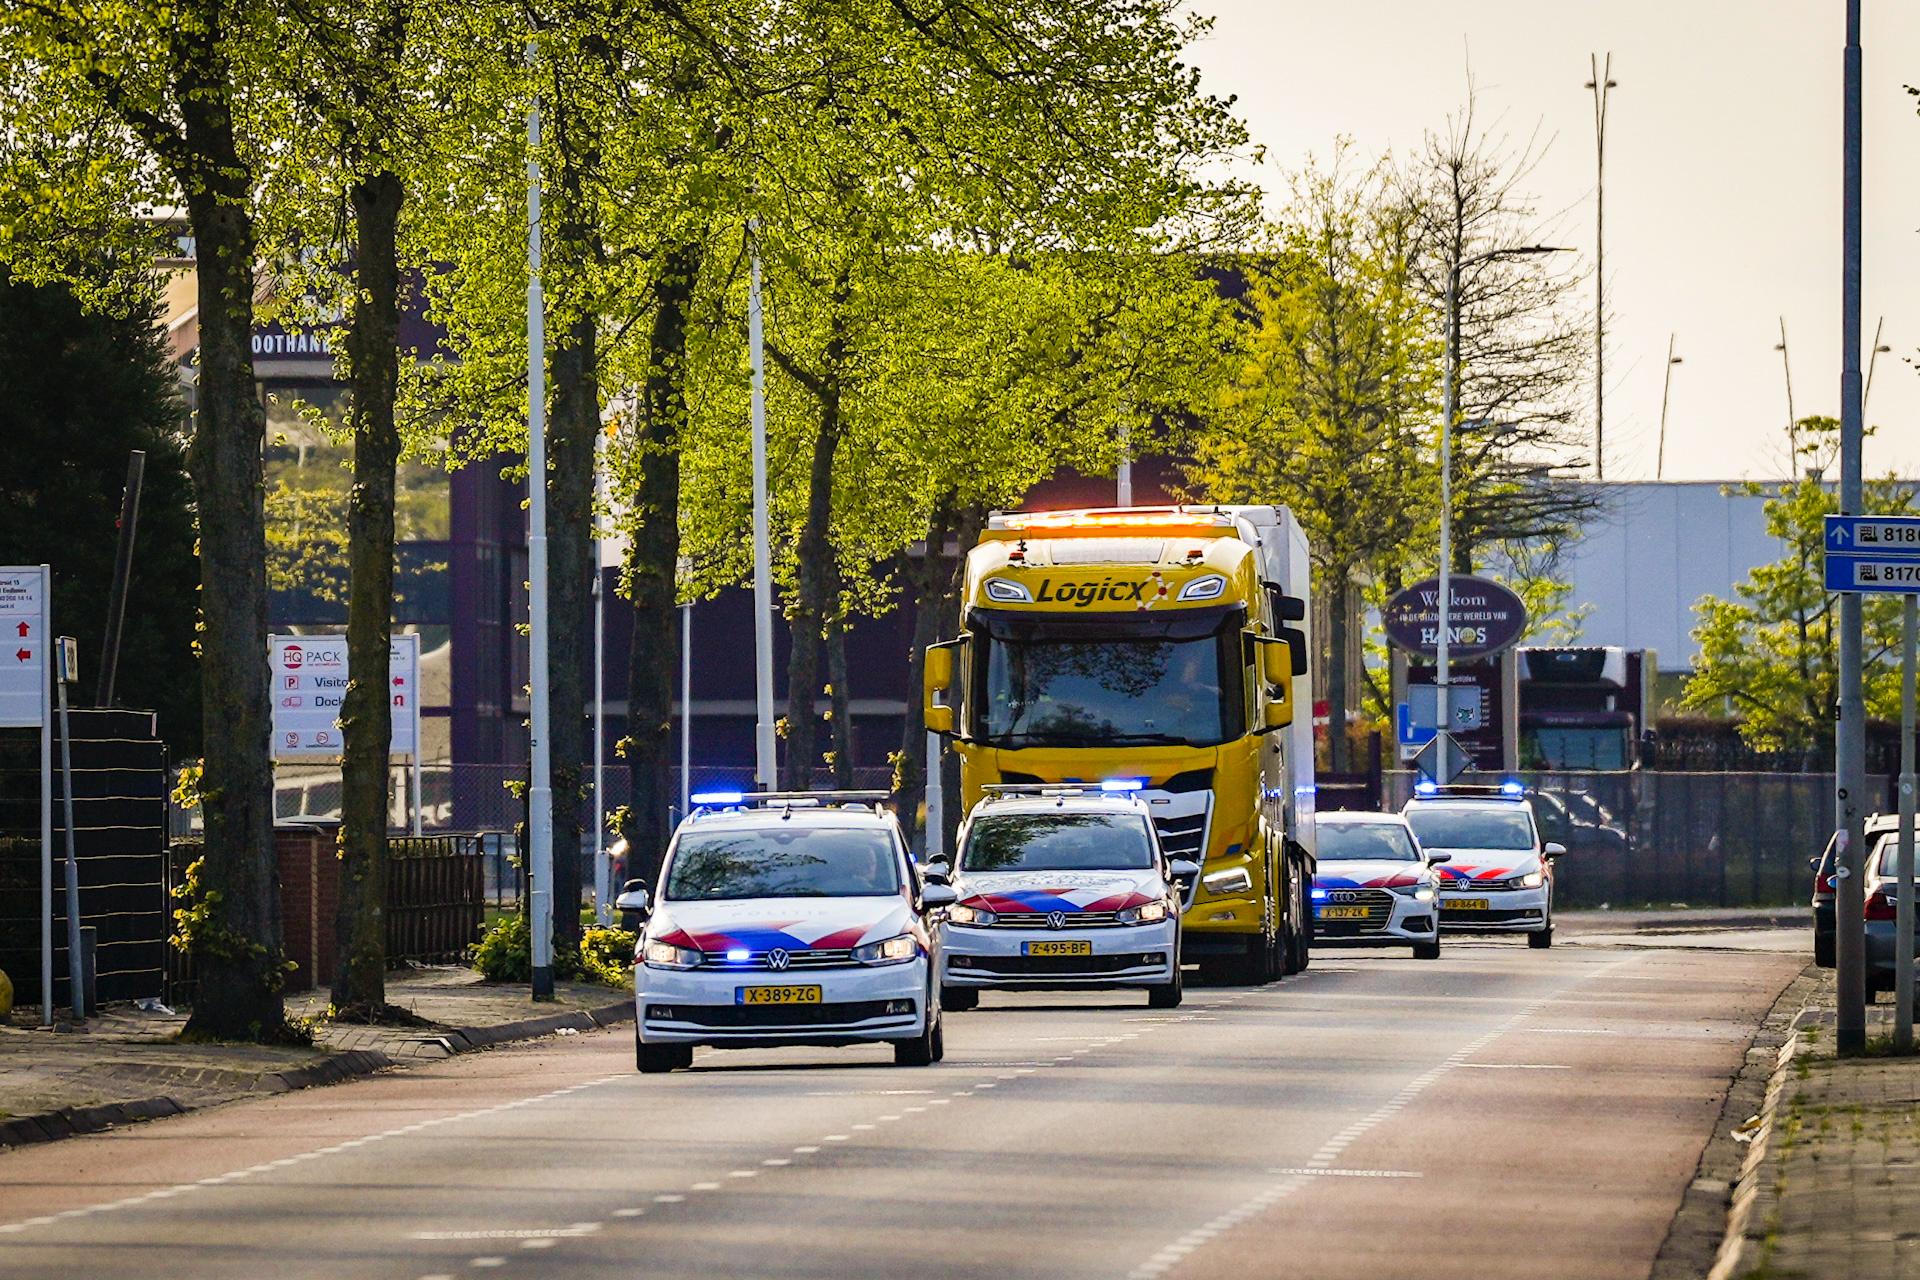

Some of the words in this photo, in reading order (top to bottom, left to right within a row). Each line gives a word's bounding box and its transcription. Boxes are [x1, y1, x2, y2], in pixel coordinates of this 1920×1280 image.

[1883, 527, 1920, 542] 818
[1419, 588, 1486, 606] Wkom
[1464, 612, 1492, 620] WERELD
[1494, 612, 1507, 620] VAN
[283, 652, 302, 663] HQ
[306, 651, 341, 662] PACK
[1031, 943, 1087, 954] Z-495-BF
[748, 987, 816, 1003] X-389-ZG
